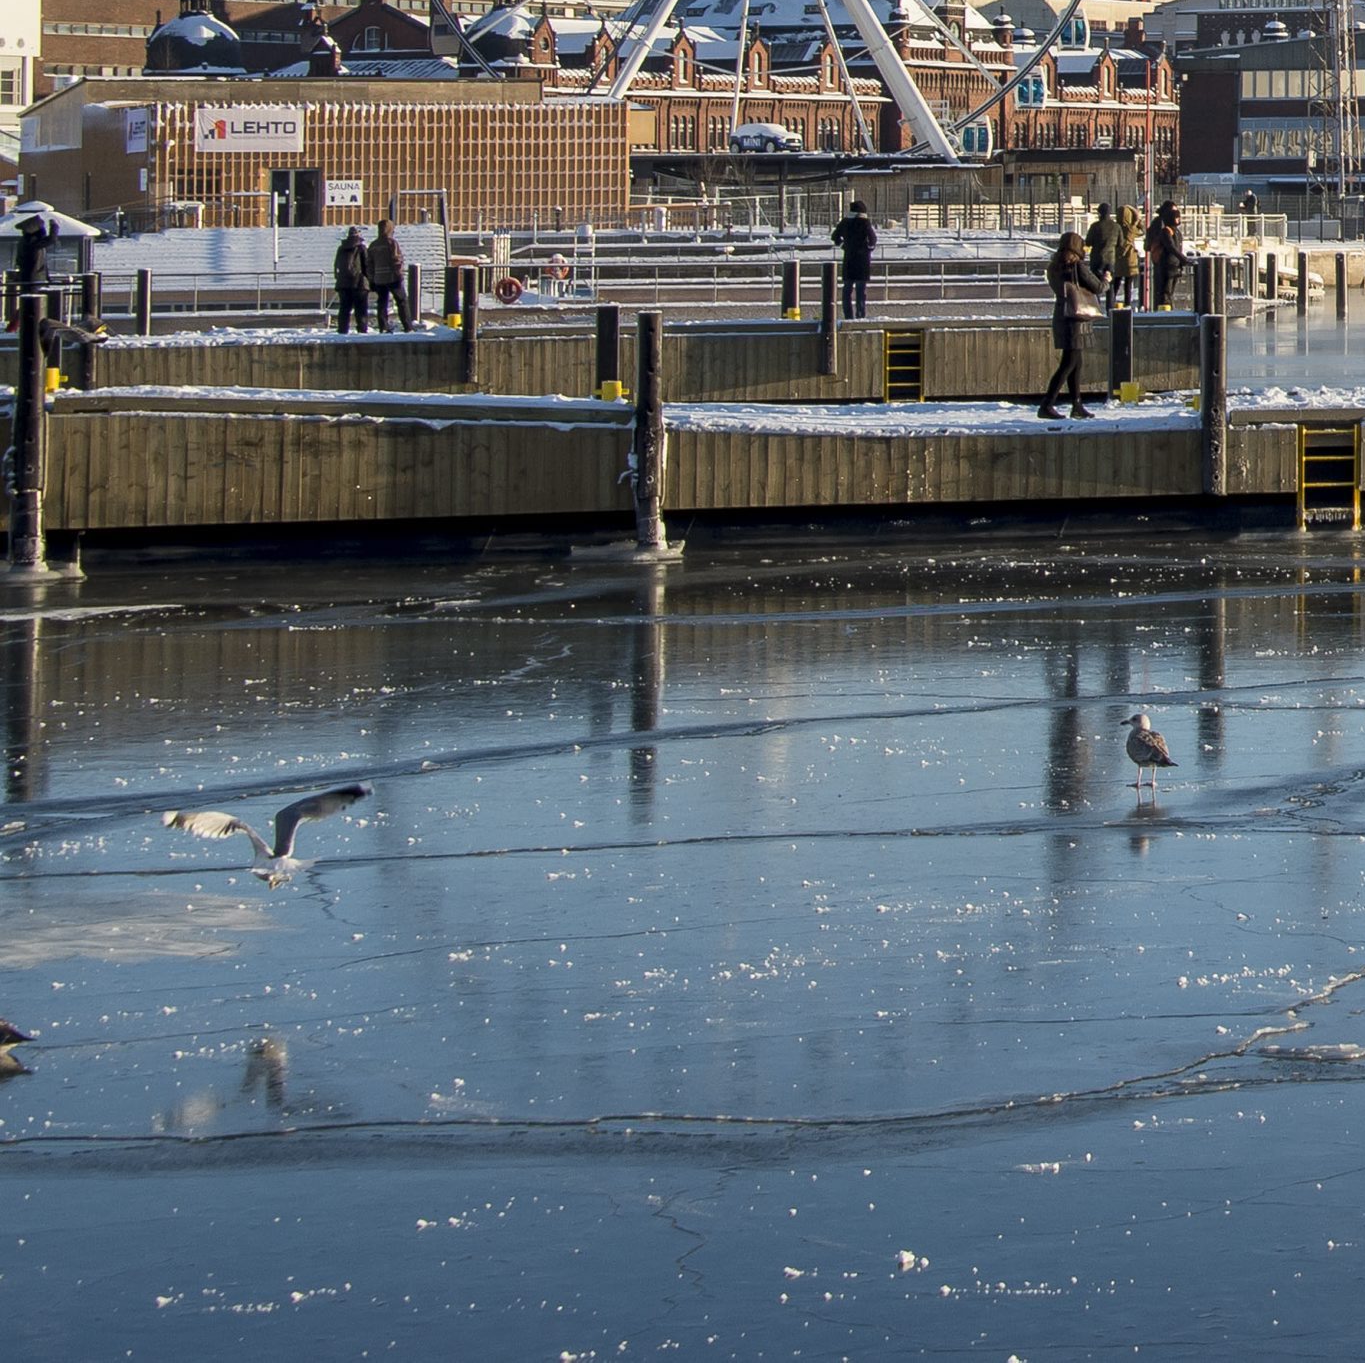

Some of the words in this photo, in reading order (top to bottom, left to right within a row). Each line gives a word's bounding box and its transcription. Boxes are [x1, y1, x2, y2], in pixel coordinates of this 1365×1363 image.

[230, 121, 296, 134] LEHTO
[743, 137, 761, 147] MINI
[327, 182, 361, 190] SAUNA
